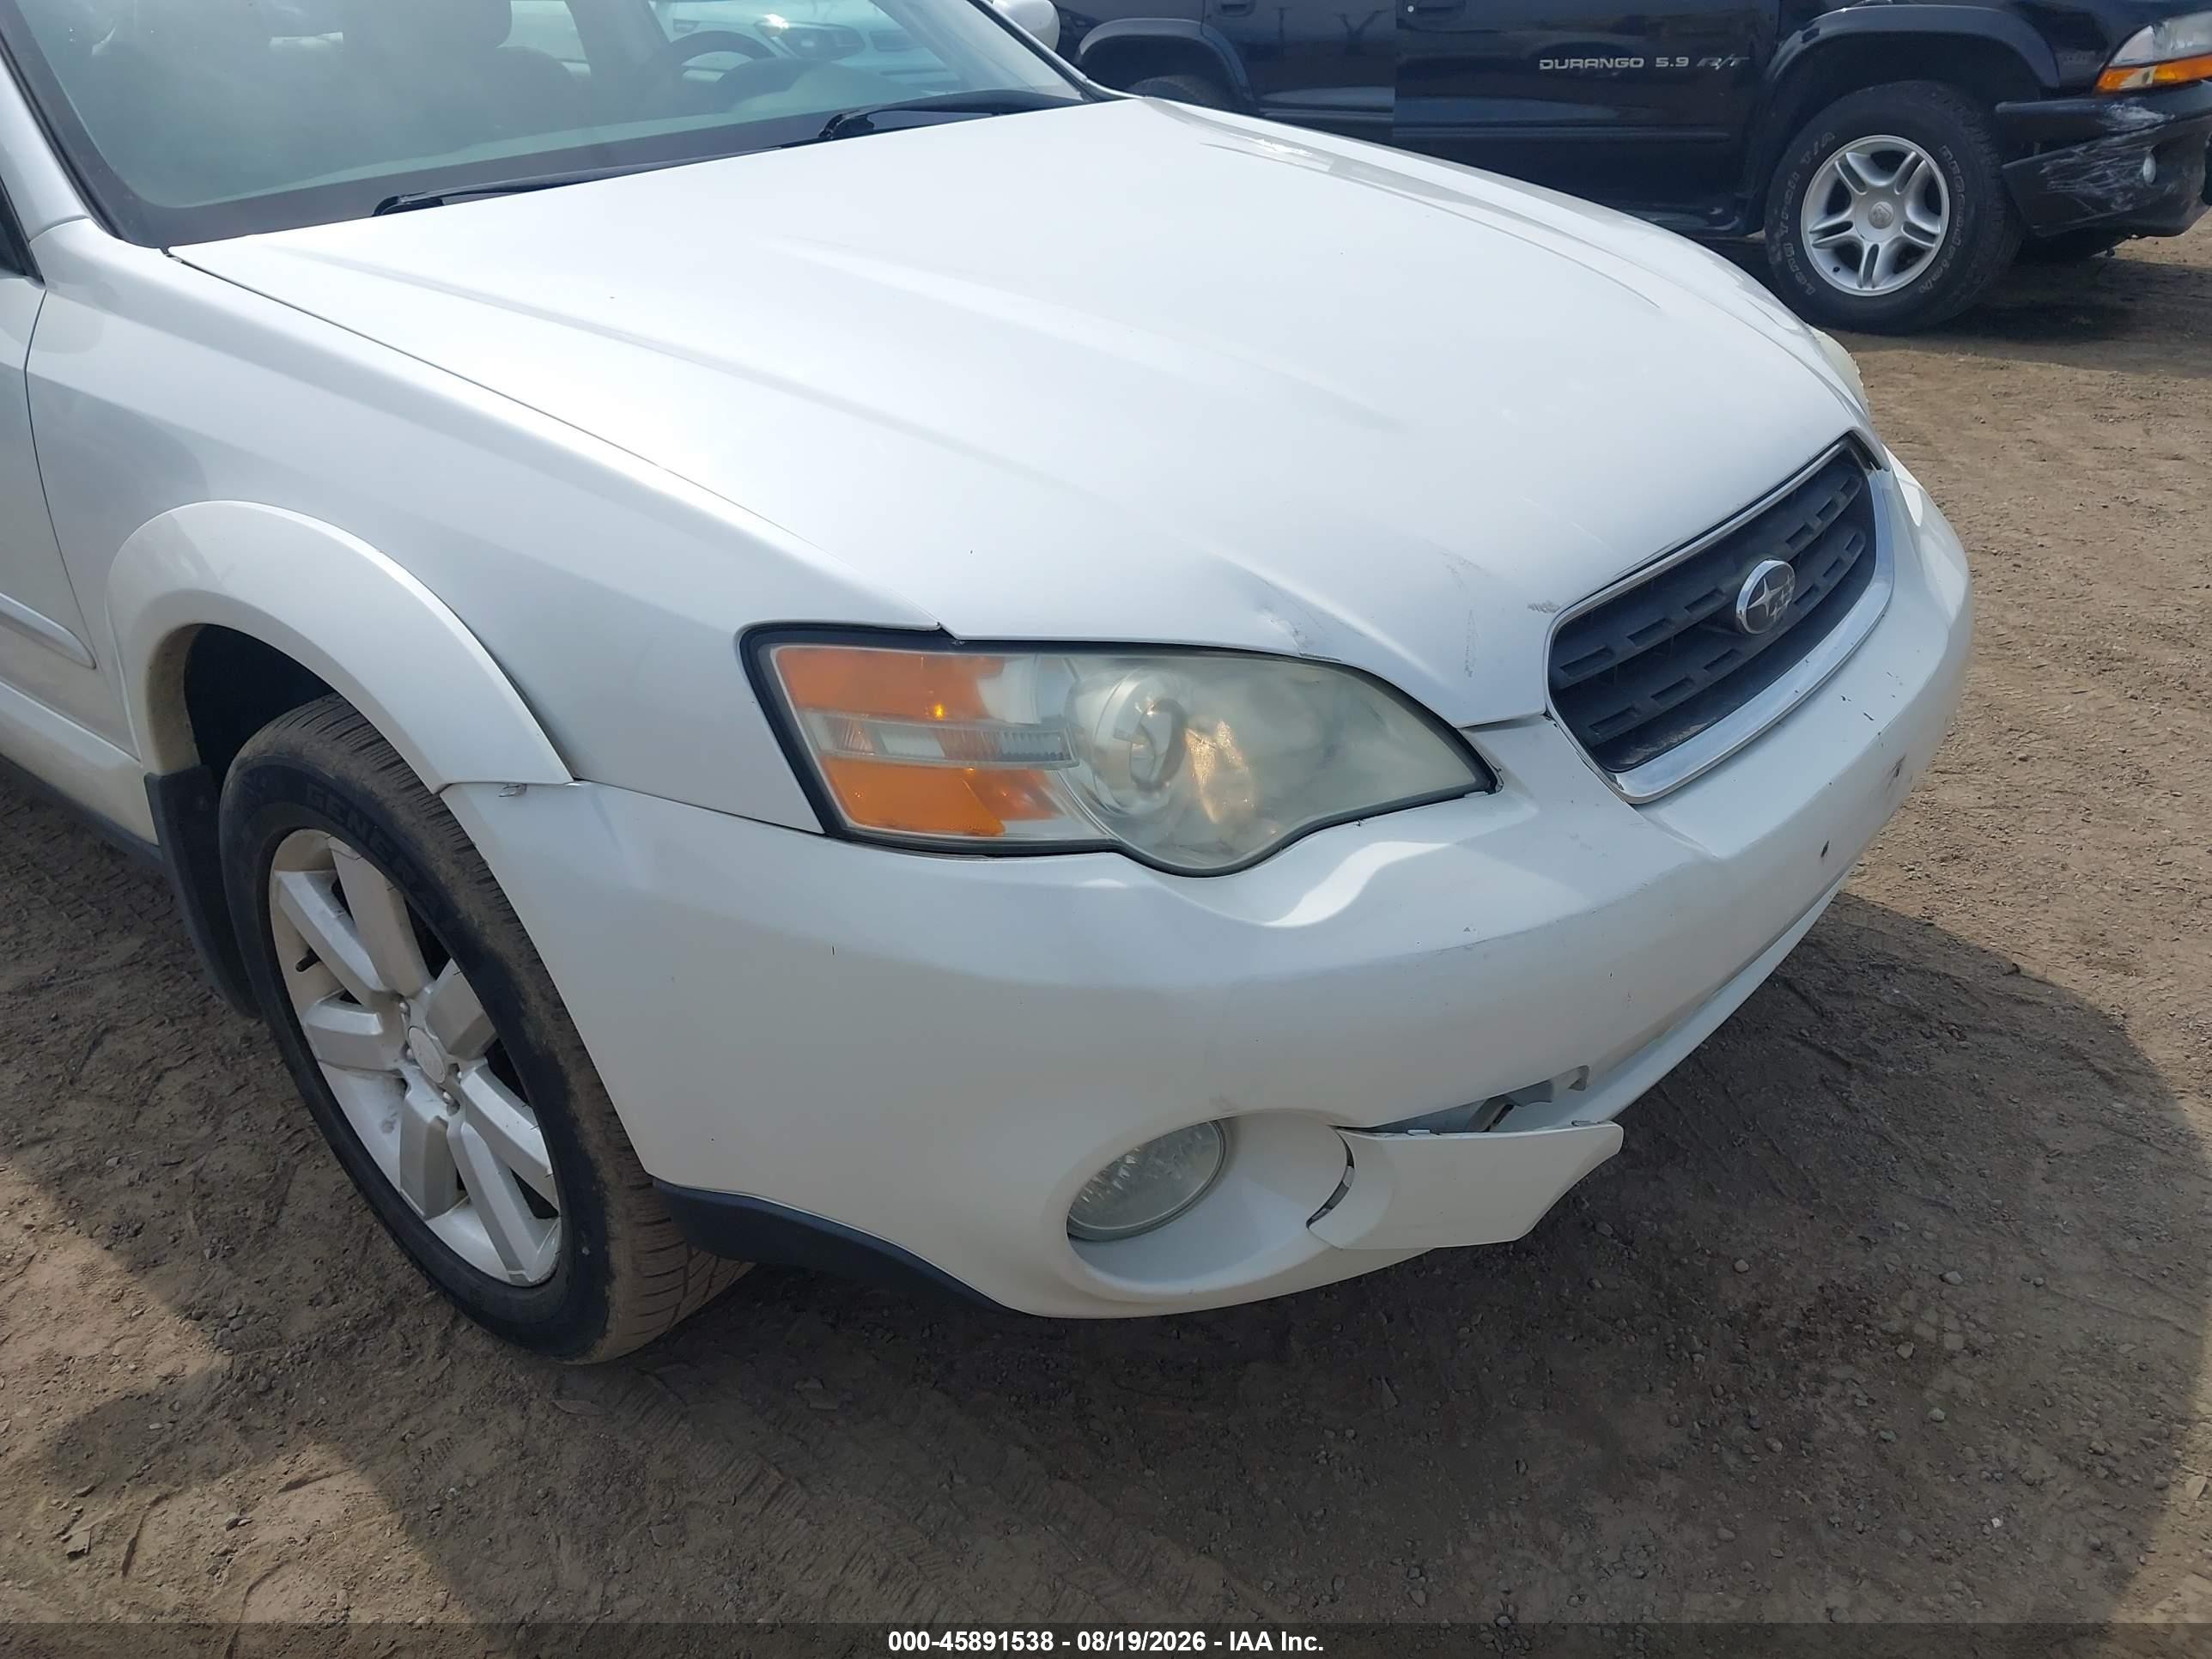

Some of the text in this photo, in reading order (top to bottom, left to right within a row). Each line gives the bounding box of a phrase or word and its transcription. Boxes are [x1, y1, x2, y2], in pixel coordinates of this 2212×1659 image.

[1539, 54, 1751, 70] DURANGO 5.9 R/T
